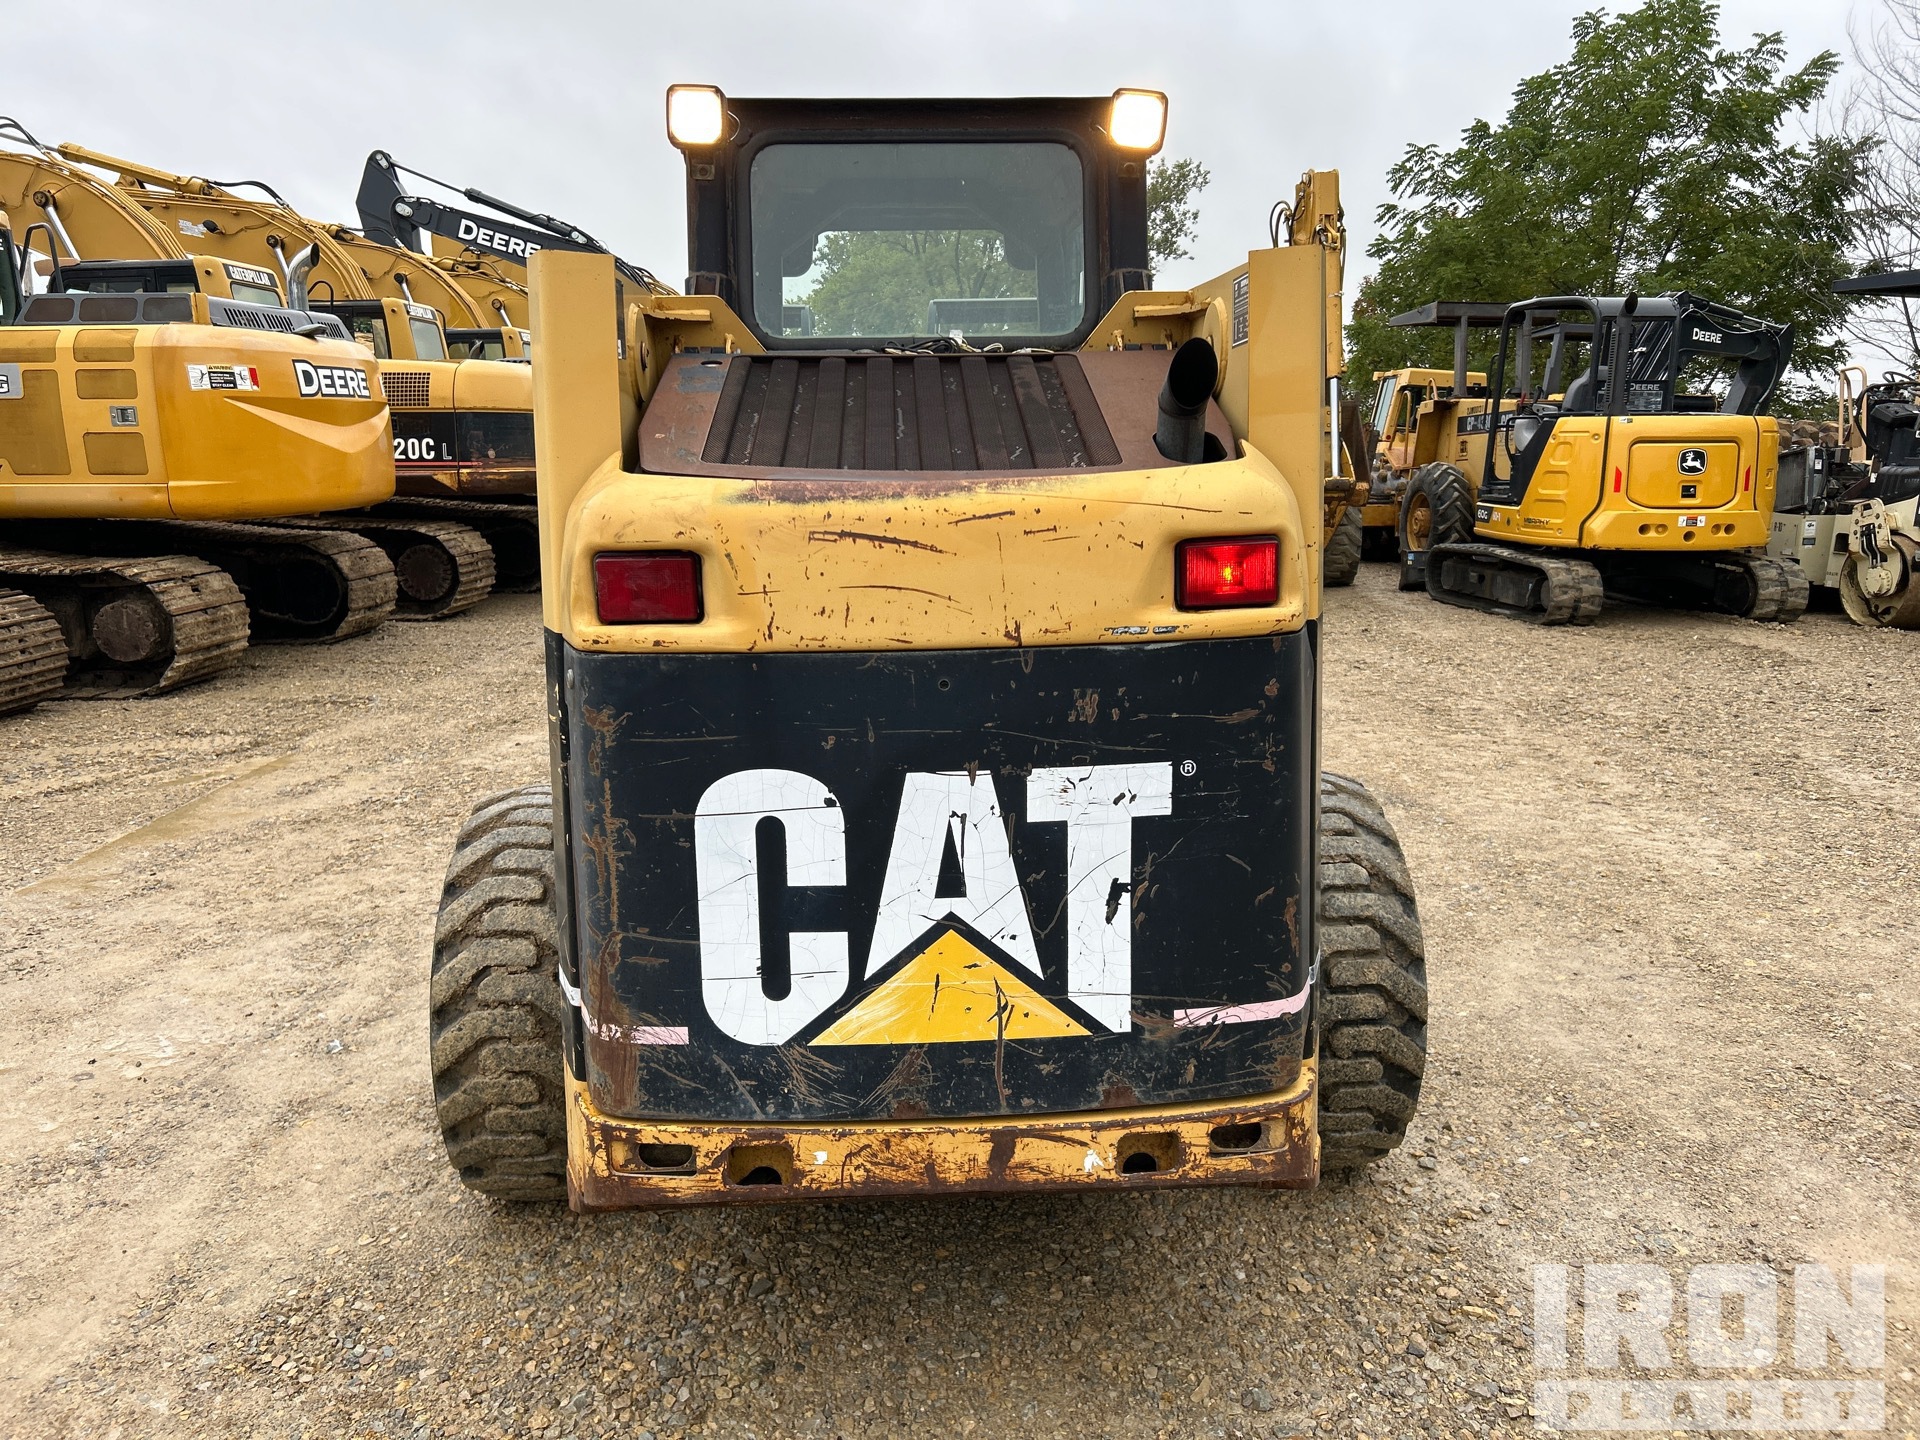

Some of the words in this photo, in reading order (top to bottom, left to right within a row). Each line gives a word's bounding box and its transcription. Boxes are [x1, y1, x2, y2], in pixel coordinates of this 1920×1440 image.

[458, 218, 541, 258] DEERE
[229, 265, 271, 286] CATERPILLAR
[1692, 327, 1722, 344] DEERE
[293, 361, 370, 398] DEERE
[1477, 509, 1488, 520] 60G
[694, 761, 1172, 1046] CAT
